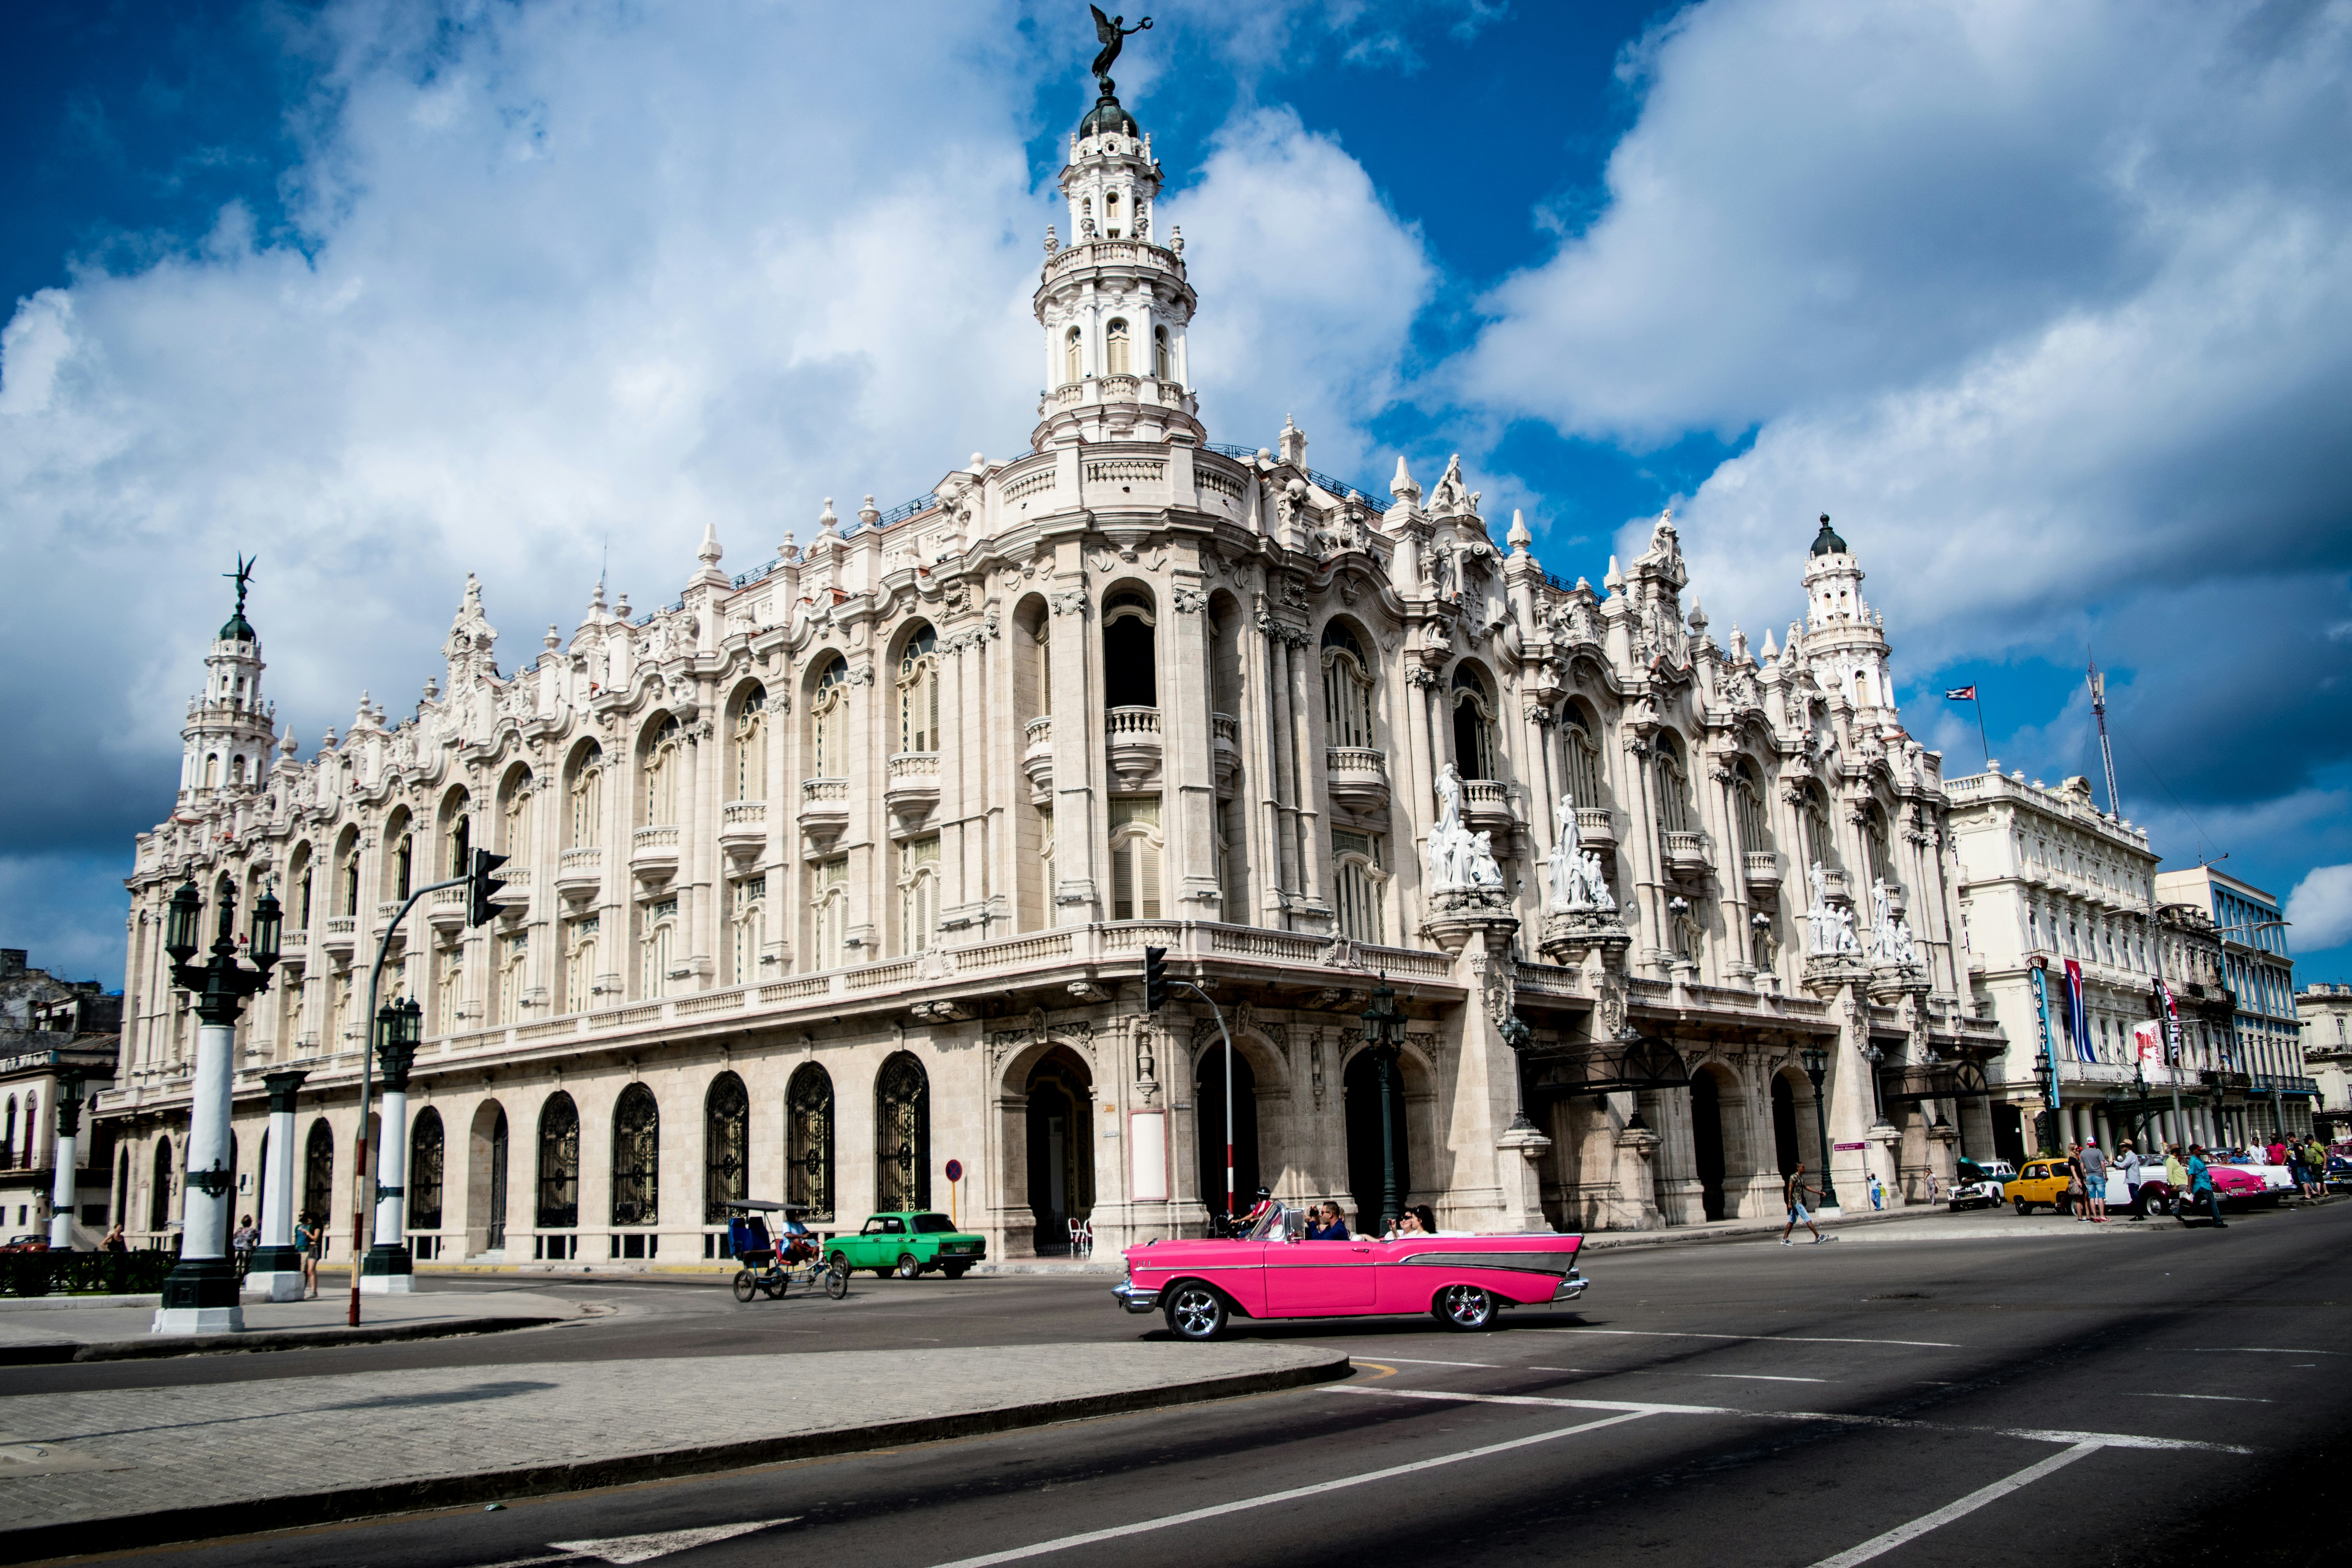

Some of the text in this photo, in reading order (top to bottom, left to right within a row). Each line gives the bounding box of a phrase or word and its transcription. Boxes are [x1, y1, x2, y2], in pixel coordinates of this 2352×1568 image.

[2026, 957, 2042, 972] HOTEL
[2033, 969, 2054, 1105] INGLAT
[2151, 1027, 2159, 1055] ALFONSO
